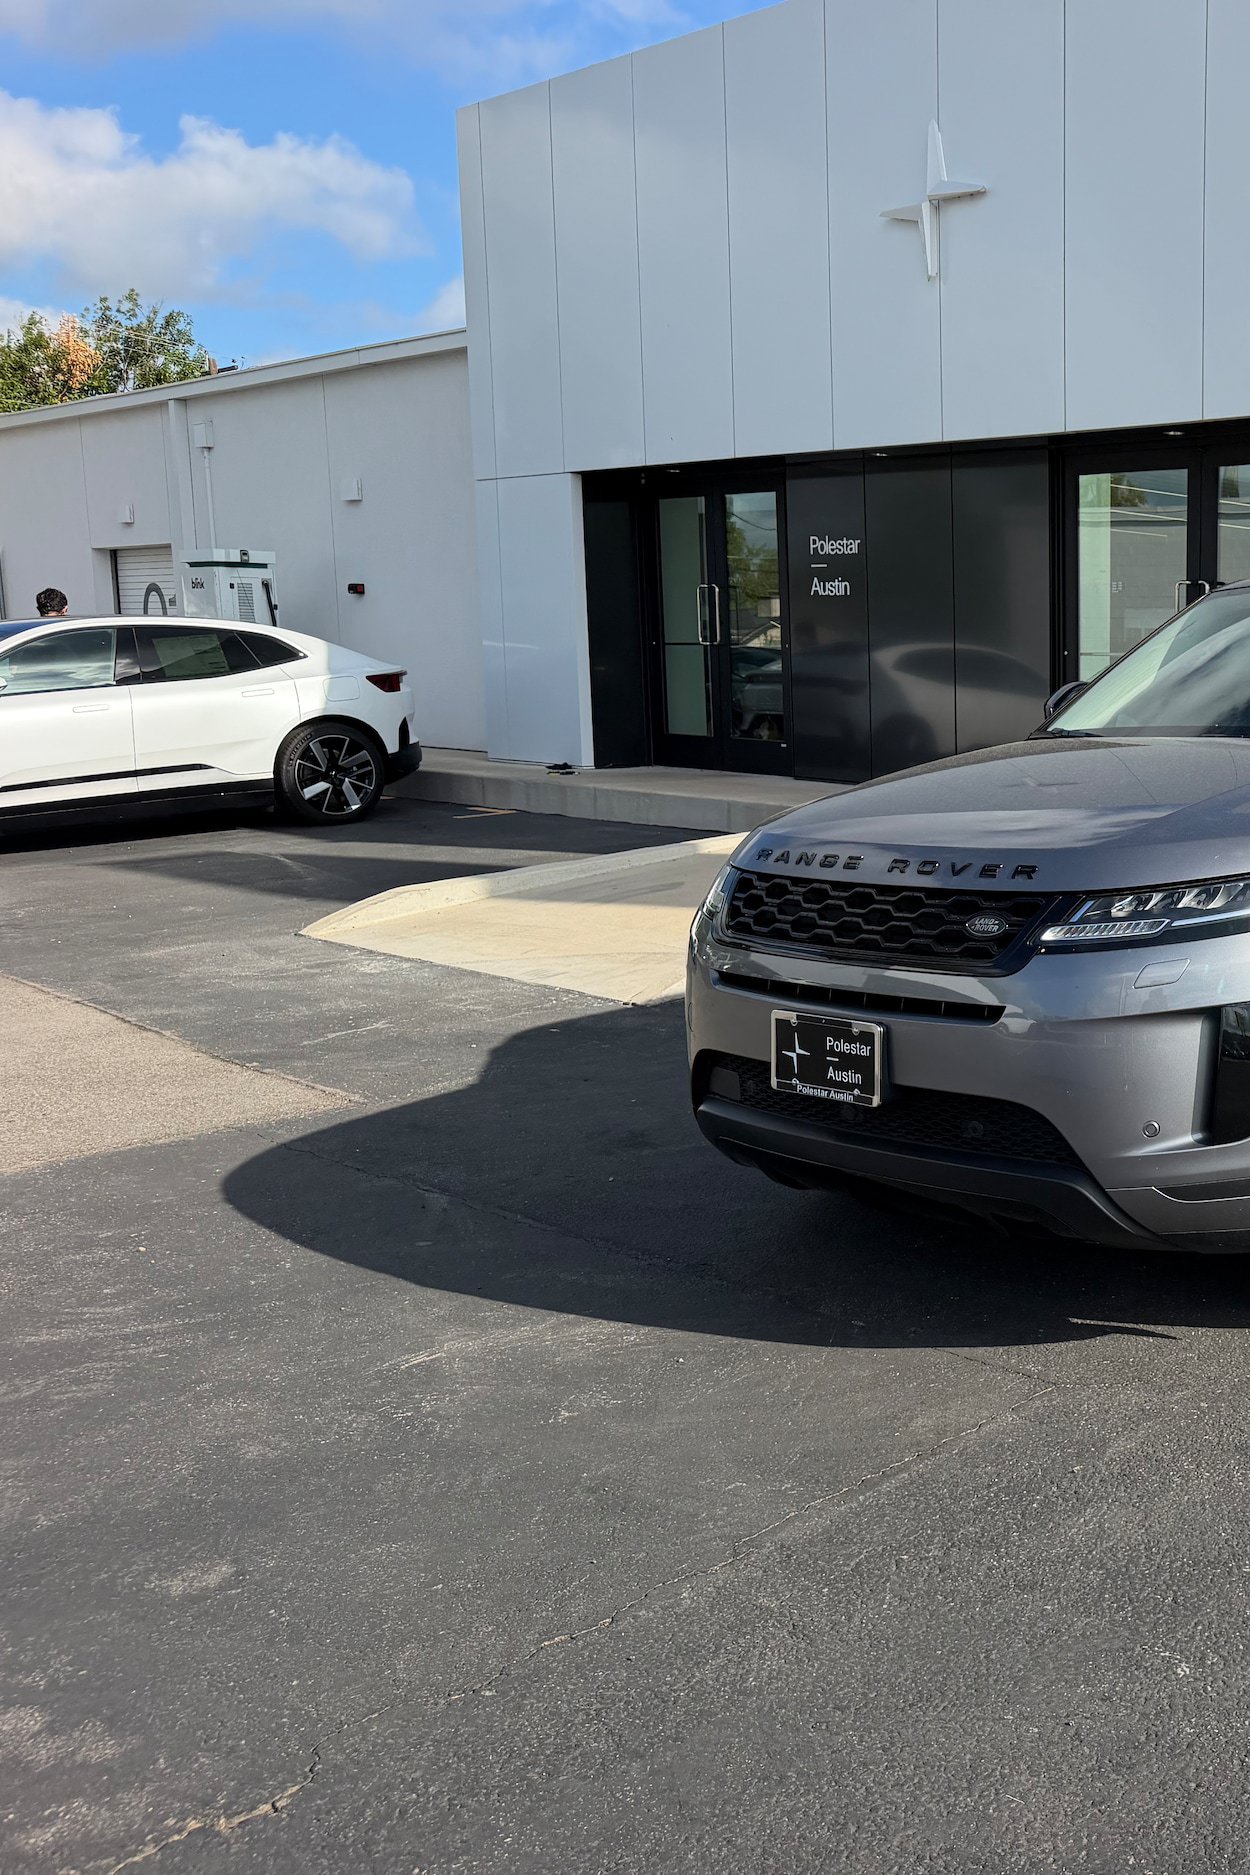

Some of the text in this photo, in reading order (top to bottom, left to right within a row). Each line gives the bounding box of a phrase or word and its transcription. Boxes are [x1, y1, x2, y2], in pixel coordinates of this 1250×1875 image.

[809, 535, 861, 555] Polestar
[191, 577, 205, 589] blink
[810, 576, 851, 596] Austin
[755, 848, 1039, 880] RANGE ROVER
[974, 924, 999, 933] ROVER
[826, 1036, 872, 1057] Polestar
[827, 1066, 862, 1085] Austin
[796, 1084, 854, 1103] Polestar Austin
